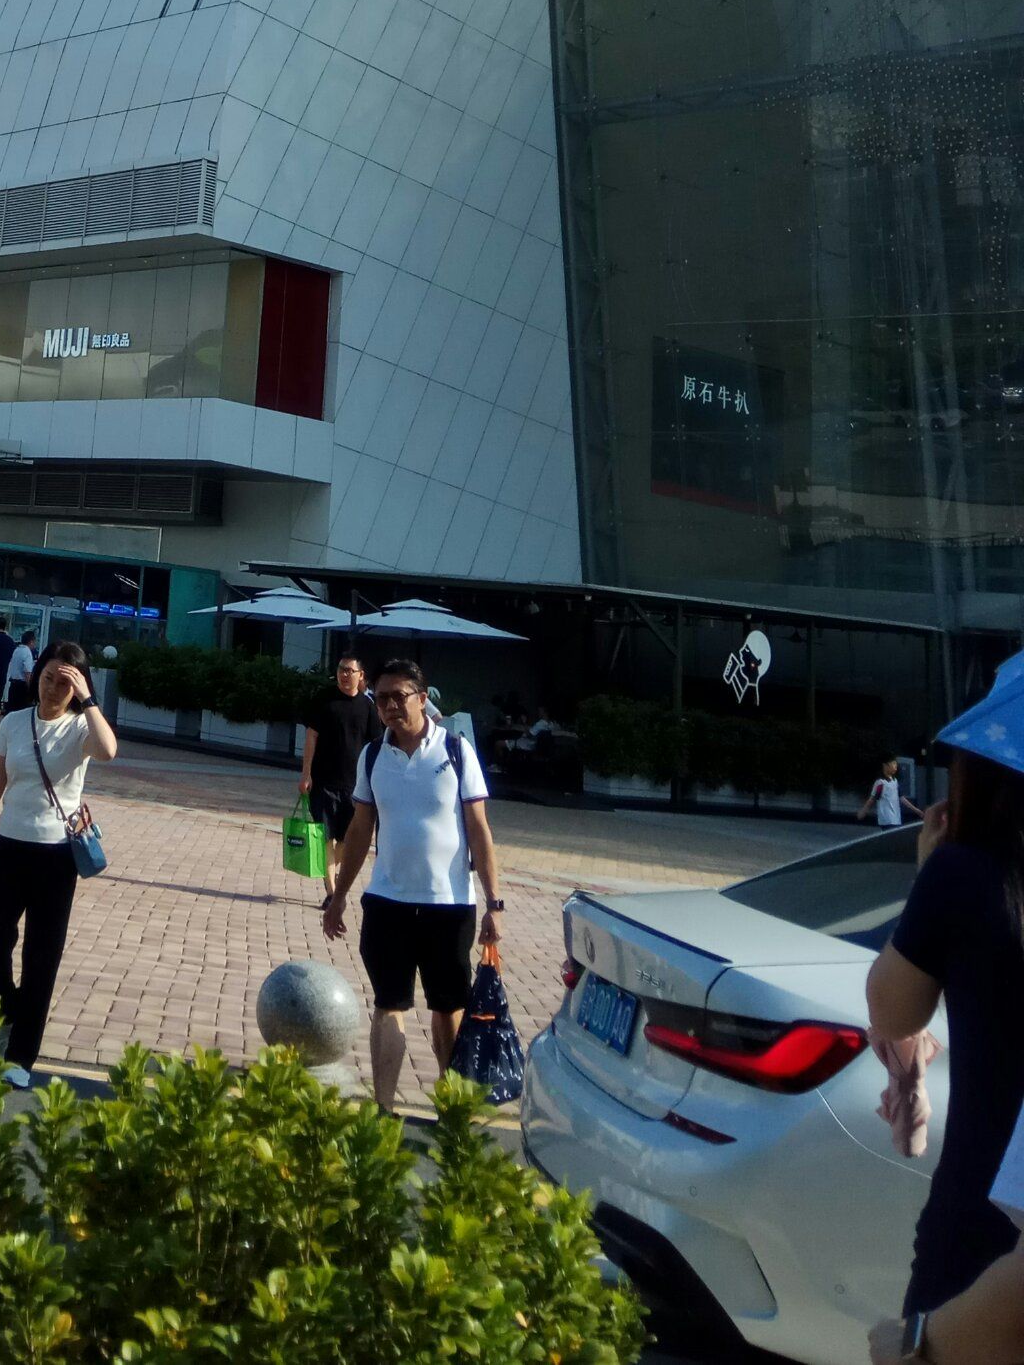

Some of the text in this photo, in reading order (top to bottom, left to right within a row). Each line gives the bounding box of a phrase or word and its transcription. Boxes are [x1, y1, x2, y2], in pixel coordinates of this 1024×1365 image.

[42, 327, 89, 358] MUJI
[91, 332, 130, 348] 無印良品
[680, 375, 750, 415] 原石牛扒
